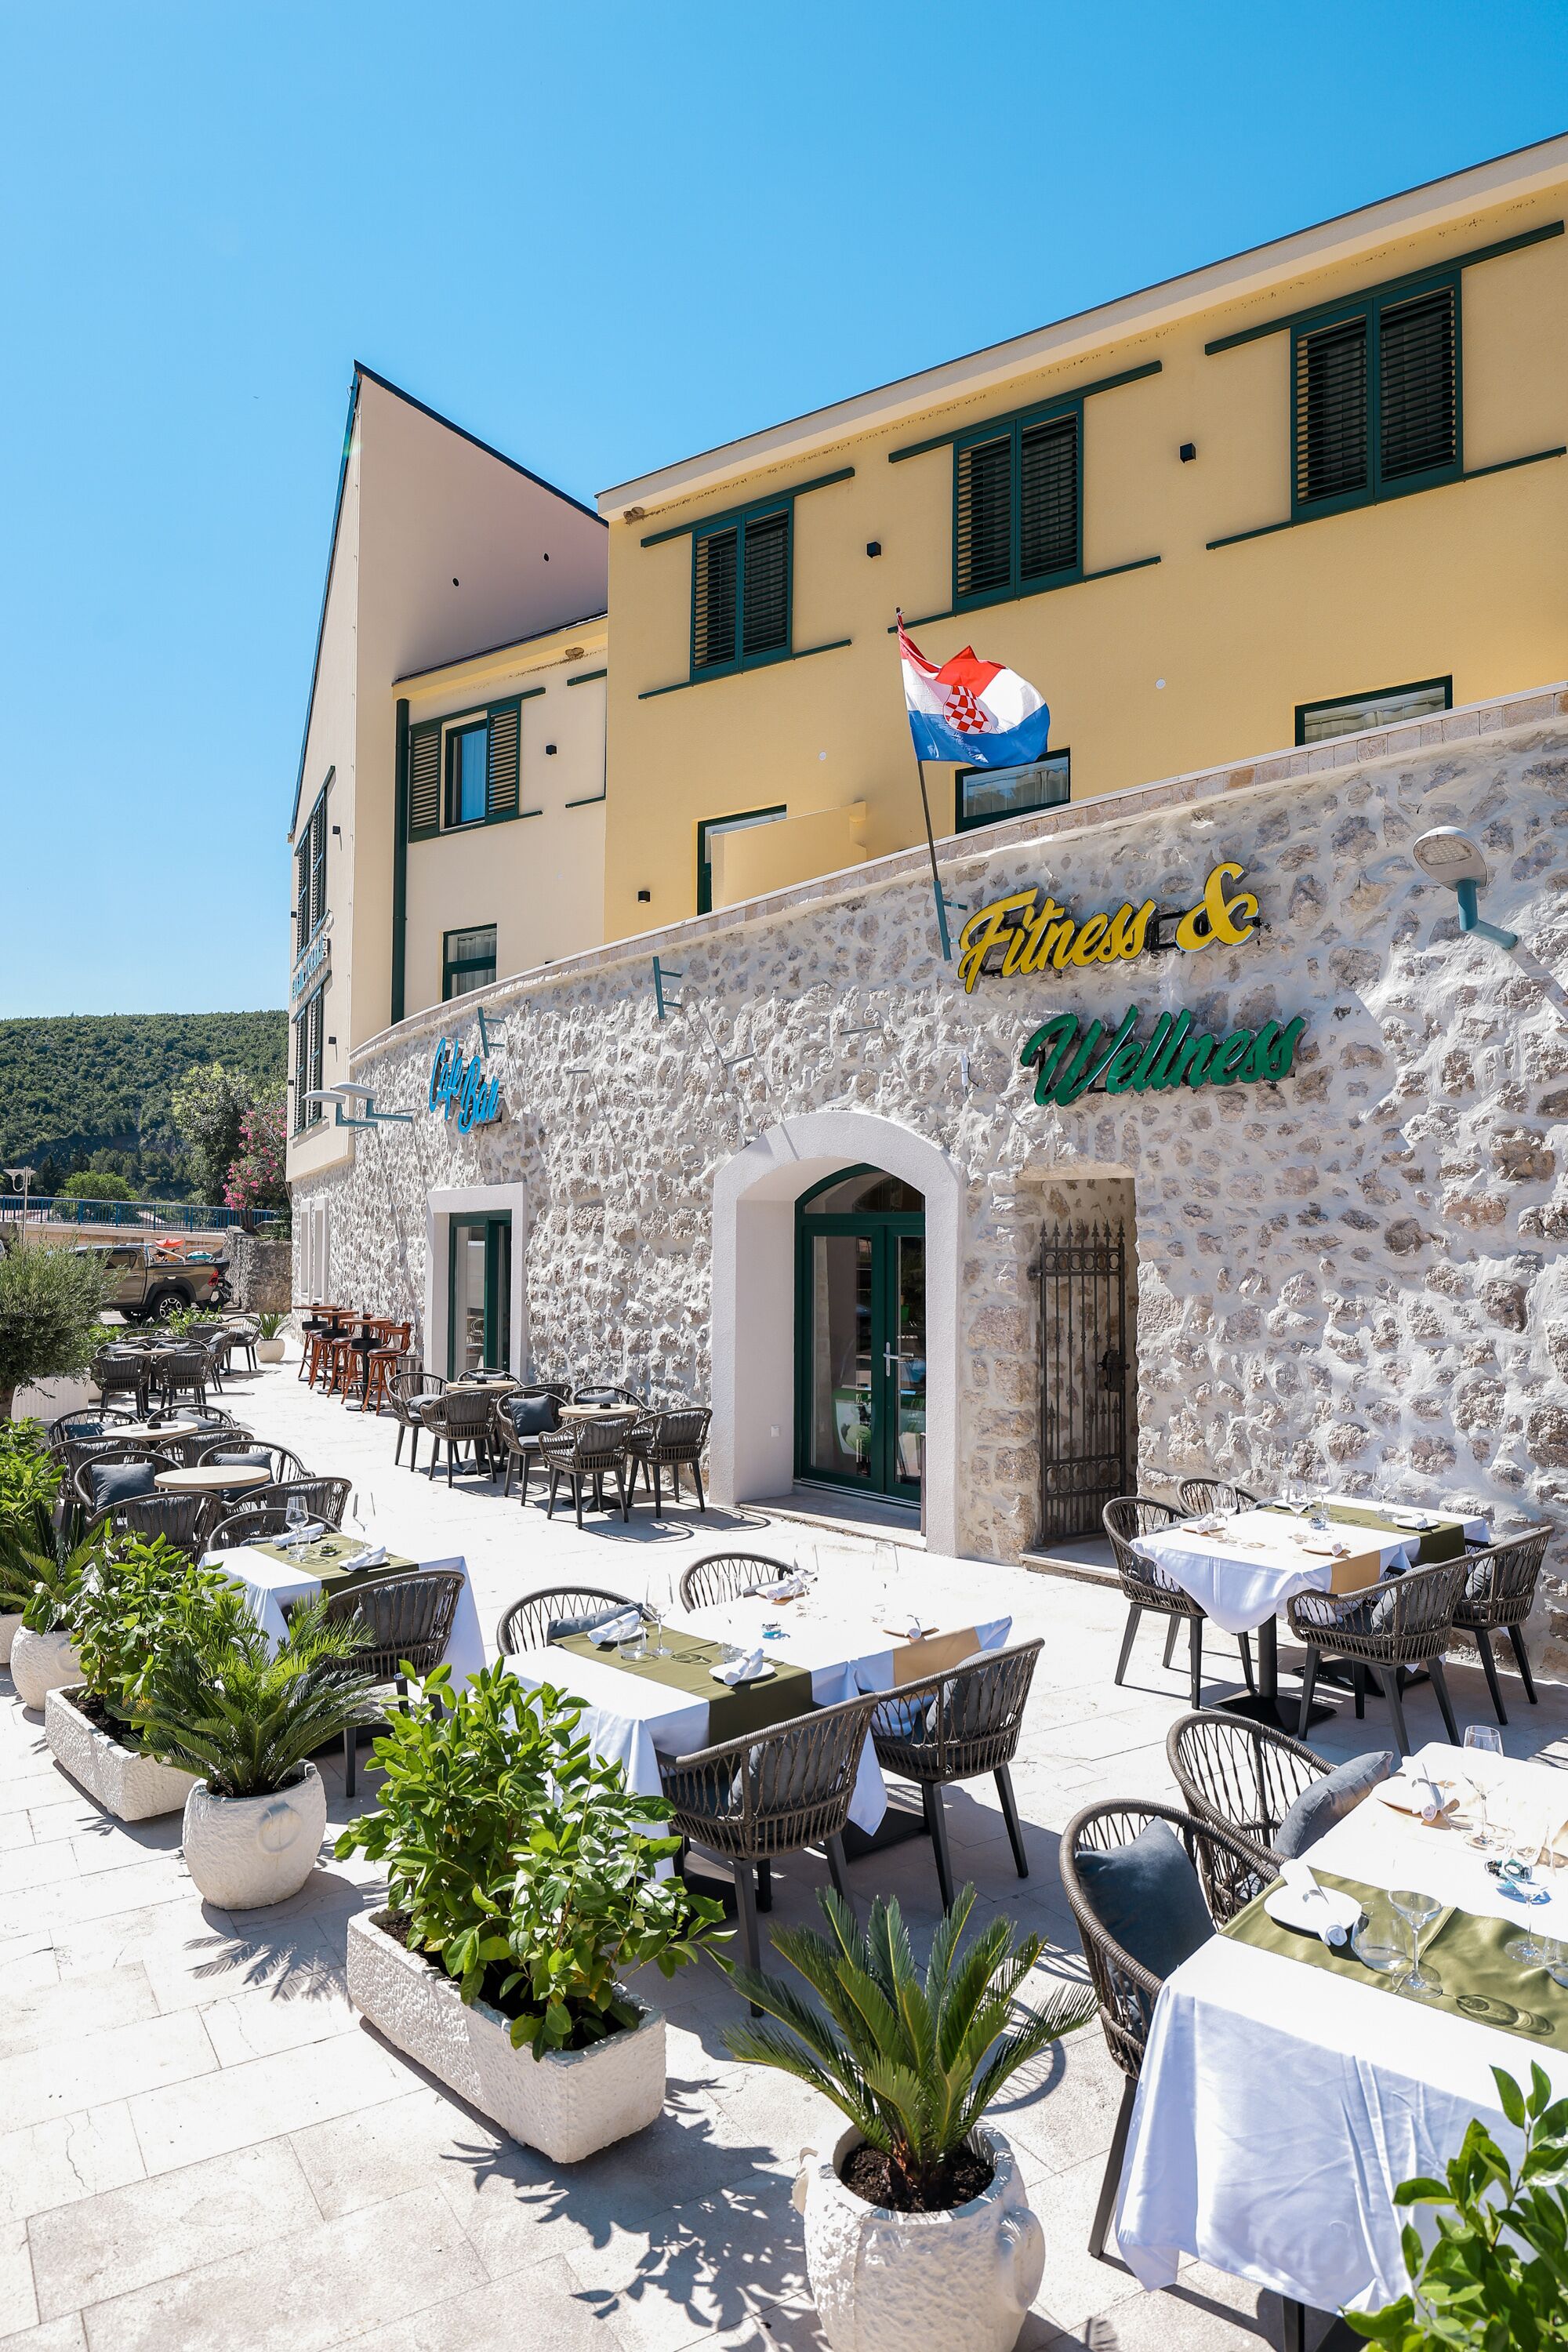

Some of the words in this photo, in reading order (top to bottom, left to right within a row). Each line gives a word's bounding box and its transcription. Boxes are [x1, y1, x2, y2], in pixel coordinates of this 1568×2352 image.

[957, 887, 1156, 995] Fitness
[1175, 861, 1259, 953] &
[458, 1055, 499, 1134] Bar
[1020, 1004, 1308, 1107] Wellness
